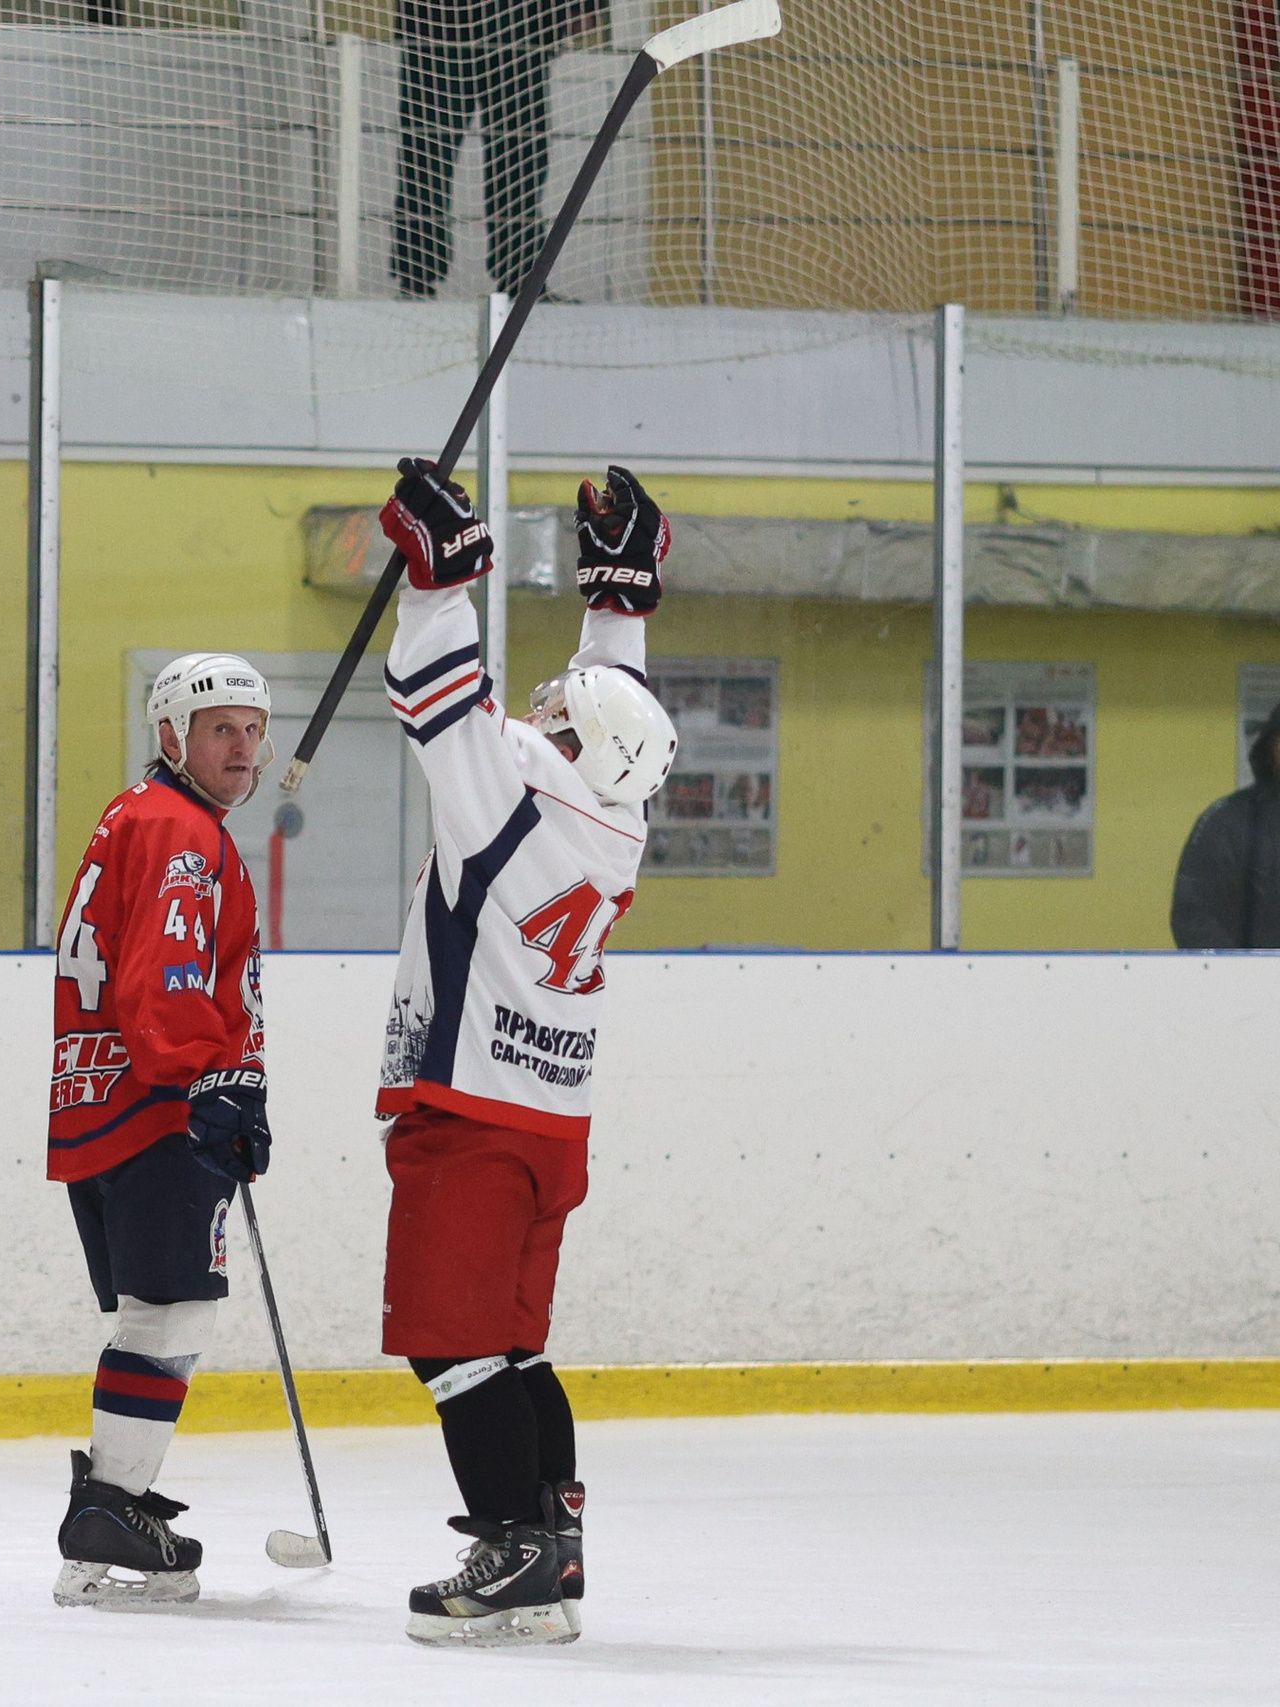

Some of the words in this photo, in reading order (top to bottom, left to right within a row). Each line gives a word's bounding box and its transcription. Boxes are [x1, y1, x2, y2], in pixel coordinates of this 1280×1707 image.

[441, 523, 490, 558] UER
[577, 566, 653, 587] BAUE
[157, 673, 182, 690] CCM
[226, 678, 255, 688] CCM
[612, 735, 634, 764] CCM
[168, 972, 205, 992] AM
[53, 1034, 130, 1078] CTIC
[49, 1071, 122, 1113] ERGY
